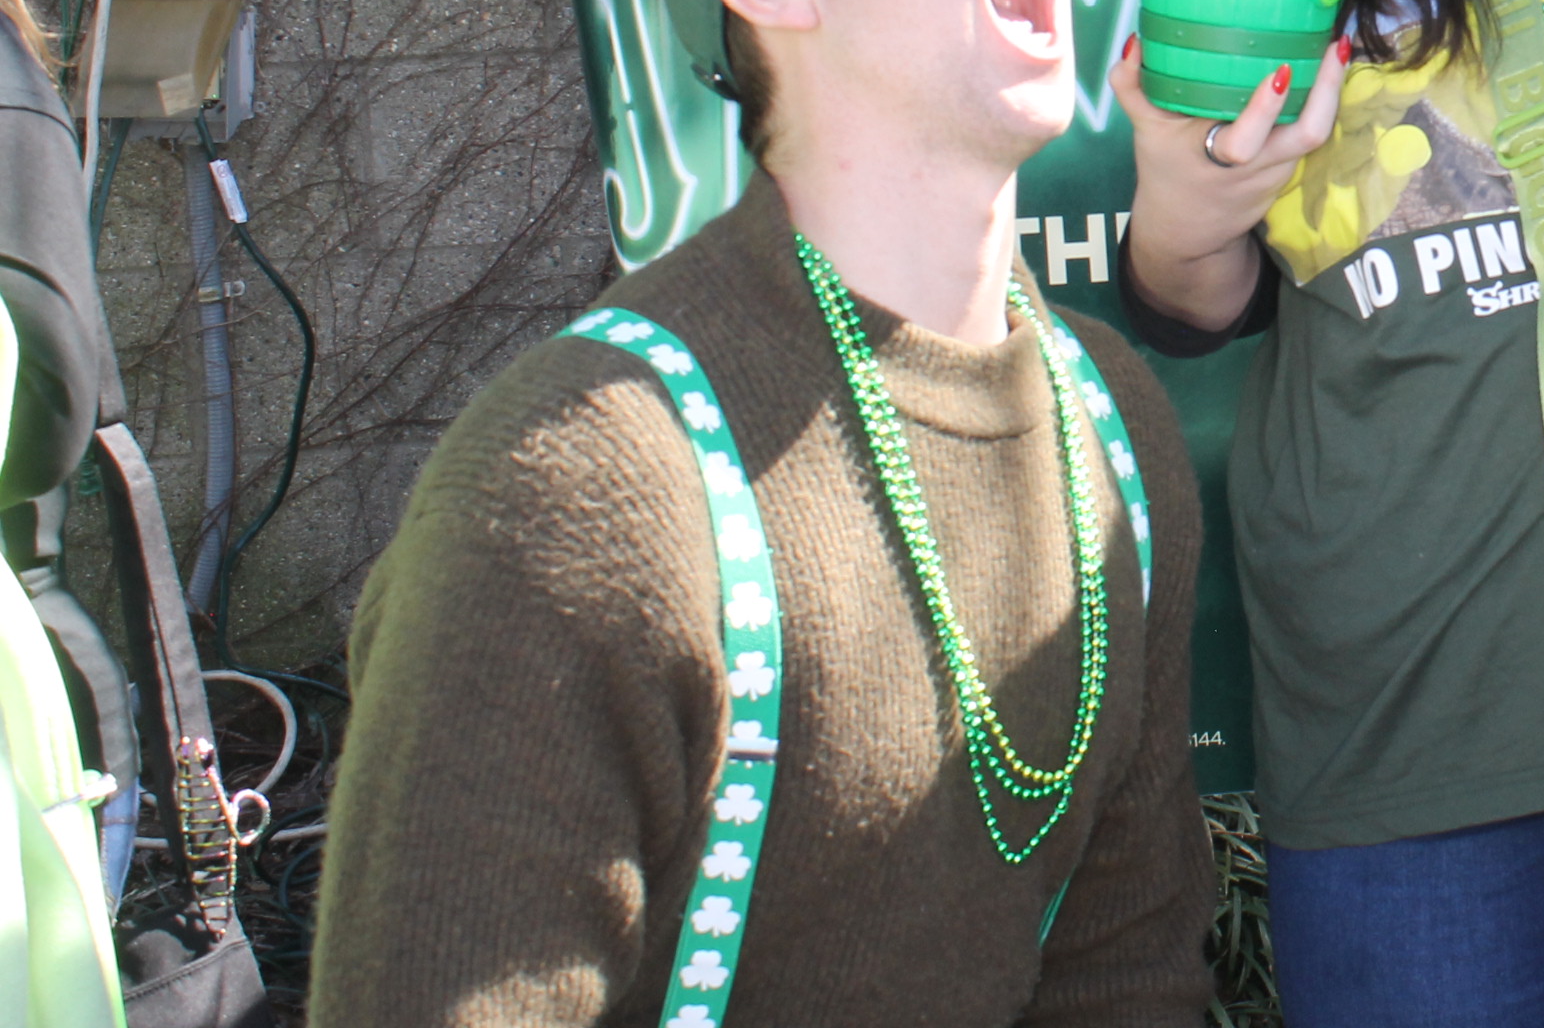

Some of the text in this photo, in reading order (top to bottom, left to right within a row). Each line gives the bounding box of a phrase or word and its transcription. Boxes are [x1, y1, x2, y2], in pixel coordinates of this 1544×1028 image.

[1014, 211, 1132, 286] TH
[1467, 280, 1541, 318] SHR
[1188, 730, 1226, 748] 144.
